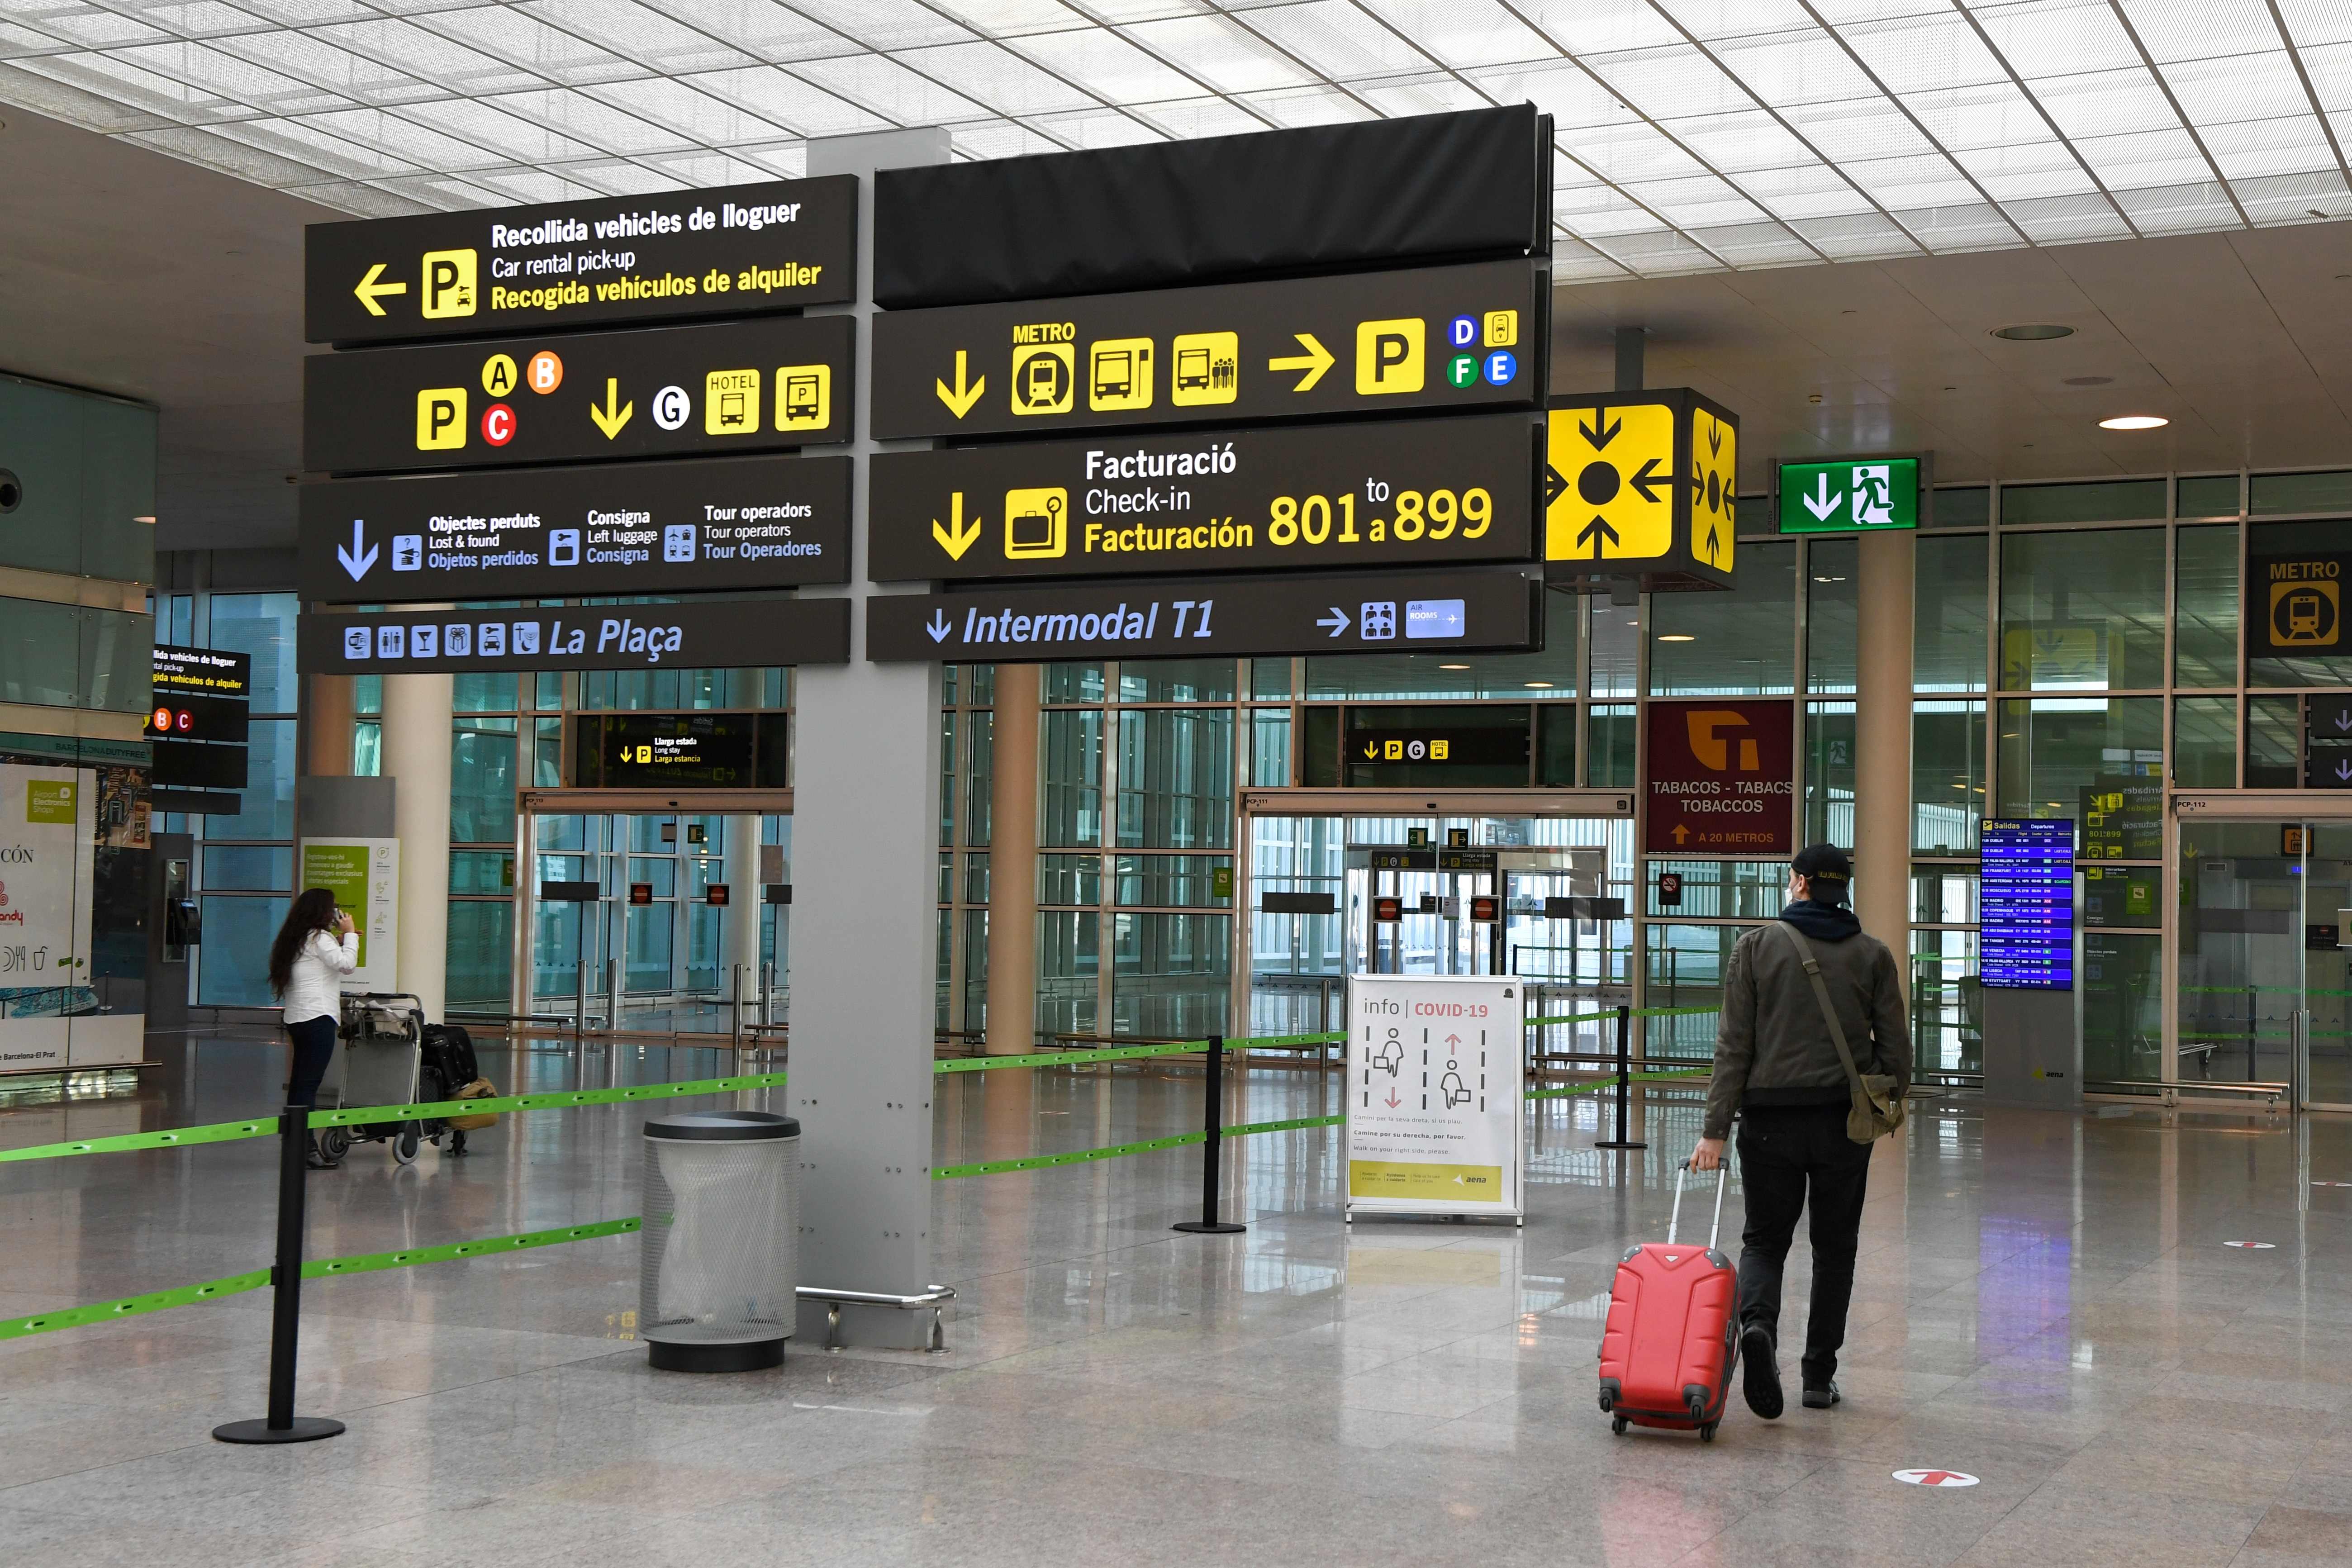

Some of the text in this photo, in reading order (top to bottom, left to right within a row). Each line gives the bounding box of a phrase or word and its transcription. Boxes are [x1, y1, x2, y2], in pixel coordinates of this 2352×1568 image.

[493, 204, 800, 247] Recollida vehicles de lloguer
[492, 249, 635, 278] Car rental pick-up
[431, 261, 458, 309] P
[492, 262, 821, 310] Recogida vehículos de alquiler
[1013, 323, 1075, 343] METRO
[1454, 320, 1473, 344] D
[1375, 333, 1409, 382] P
[491, 362, 508, 390] A
[534, 357, 557, 390] B
[1455, 359, 1471, 384] F
[1491, 356, 1507, 380] E
[712, 375, 755, 390] HOTEL
[799, 388, 807, 401] P
[662, 392, 679, 422] G
[431, 400, 455, 440] P
[488, 409, 509, 442] C
[1087, 443, 1235, 479] Facturació
[1366, 478, 1389, 502] to
[1086, 486, 1190, 514] Check-in
[588, 509, 650, 527] Consigna
[704, 503, 811, 522] Tour operadors
[1269, 494, 1359, 545] 801
[1394, 488, 1492, 540] 899
[429, 513, 540, 534] Objectes perduts
[704, 524, 791, 540] Tour operators
[1369, 519, 1384, 542] a
[430, 534, 499, 548] Lost & found
[588, 530, 657, 545] Left luggage
[1085, 519, 1252, 552] Facturación
[587, 547, 648, 565] Consigna
[703, 541, 821, 560] Tour Operadores
[429, 551, 538, 570] Objetos perdidos
[2270, 561, 2339, 580] METRO
[963, 600, 1212, 642] Intermodal T1
[549, 619, 682, 662] La Plaça
[164, 664, 184, 673] pick-up
[170, 653, 199, 662] vehicles
[201, 655, 210, 664] de
[212, 656, 236, 667] lloguer
[171, 675, 242, 689] vehículos de alquiler
[158, 712, 166, 727] B
[180, 714, 188, 729] C
[655, 738, 674, 746] Llarga
[1390, 744, 1398, 756] P
[1412, 745, 1420, 755] G
[641, 749, 647, 760] P
[33, 790, 58, 798] Airport
[1652, 781, 1793, 794] TABACOS TABACS
[33, 798, 71, 806] Electronics
[1681, 800, 1763, 812] TOBACCOS
[1699, 833, 1774, 843] A 20 METROS
[1365, 998, 1487, 1017] info COVID-19
